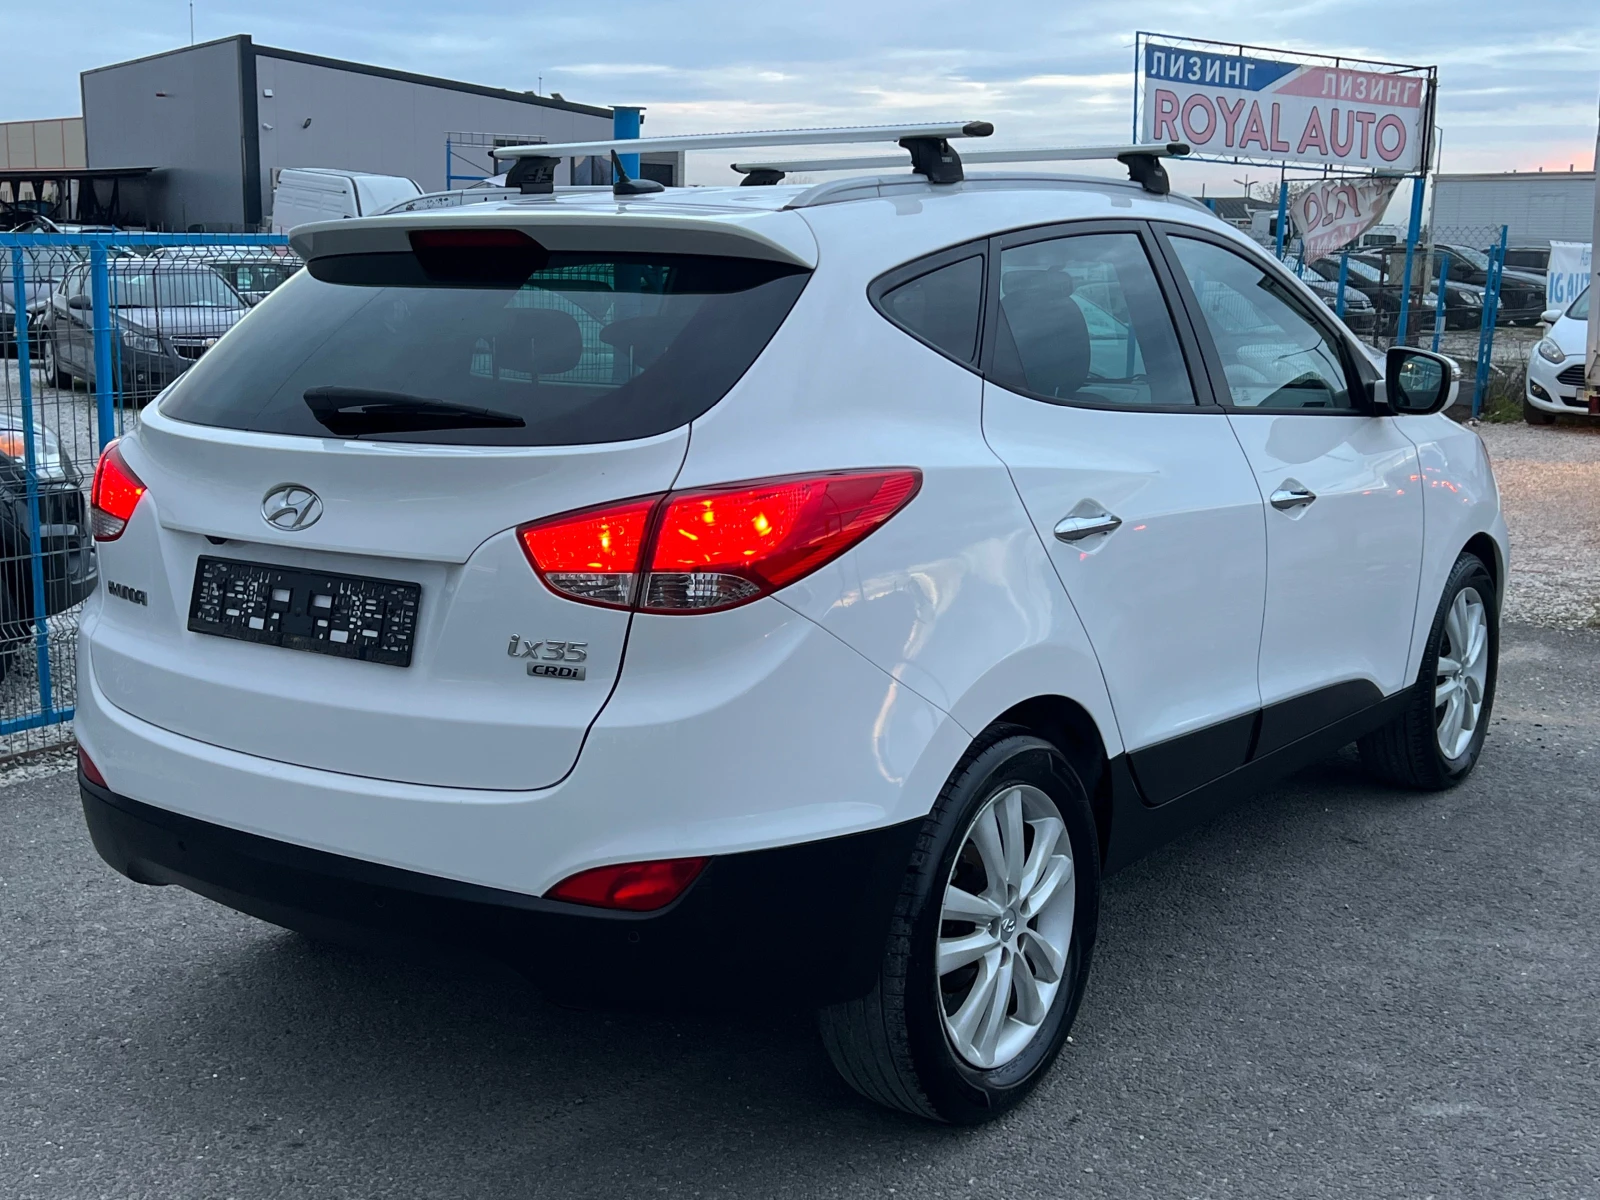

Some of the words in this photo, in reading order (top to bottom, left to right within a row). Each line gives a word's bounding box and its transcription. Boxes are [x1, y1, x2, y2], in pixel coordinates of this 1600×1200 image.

[1151, 51, 1255, 86] ЛИЗИНГ
[1322, 73, 1416, 104] ЛИЗИНГ
[1154, 88, 1289, 152] ROYAL
[1297, 106, 1406, 161] AUTO
[508, 633, 588, 662] ix35
[532, 665, 579, 678] CRDi
